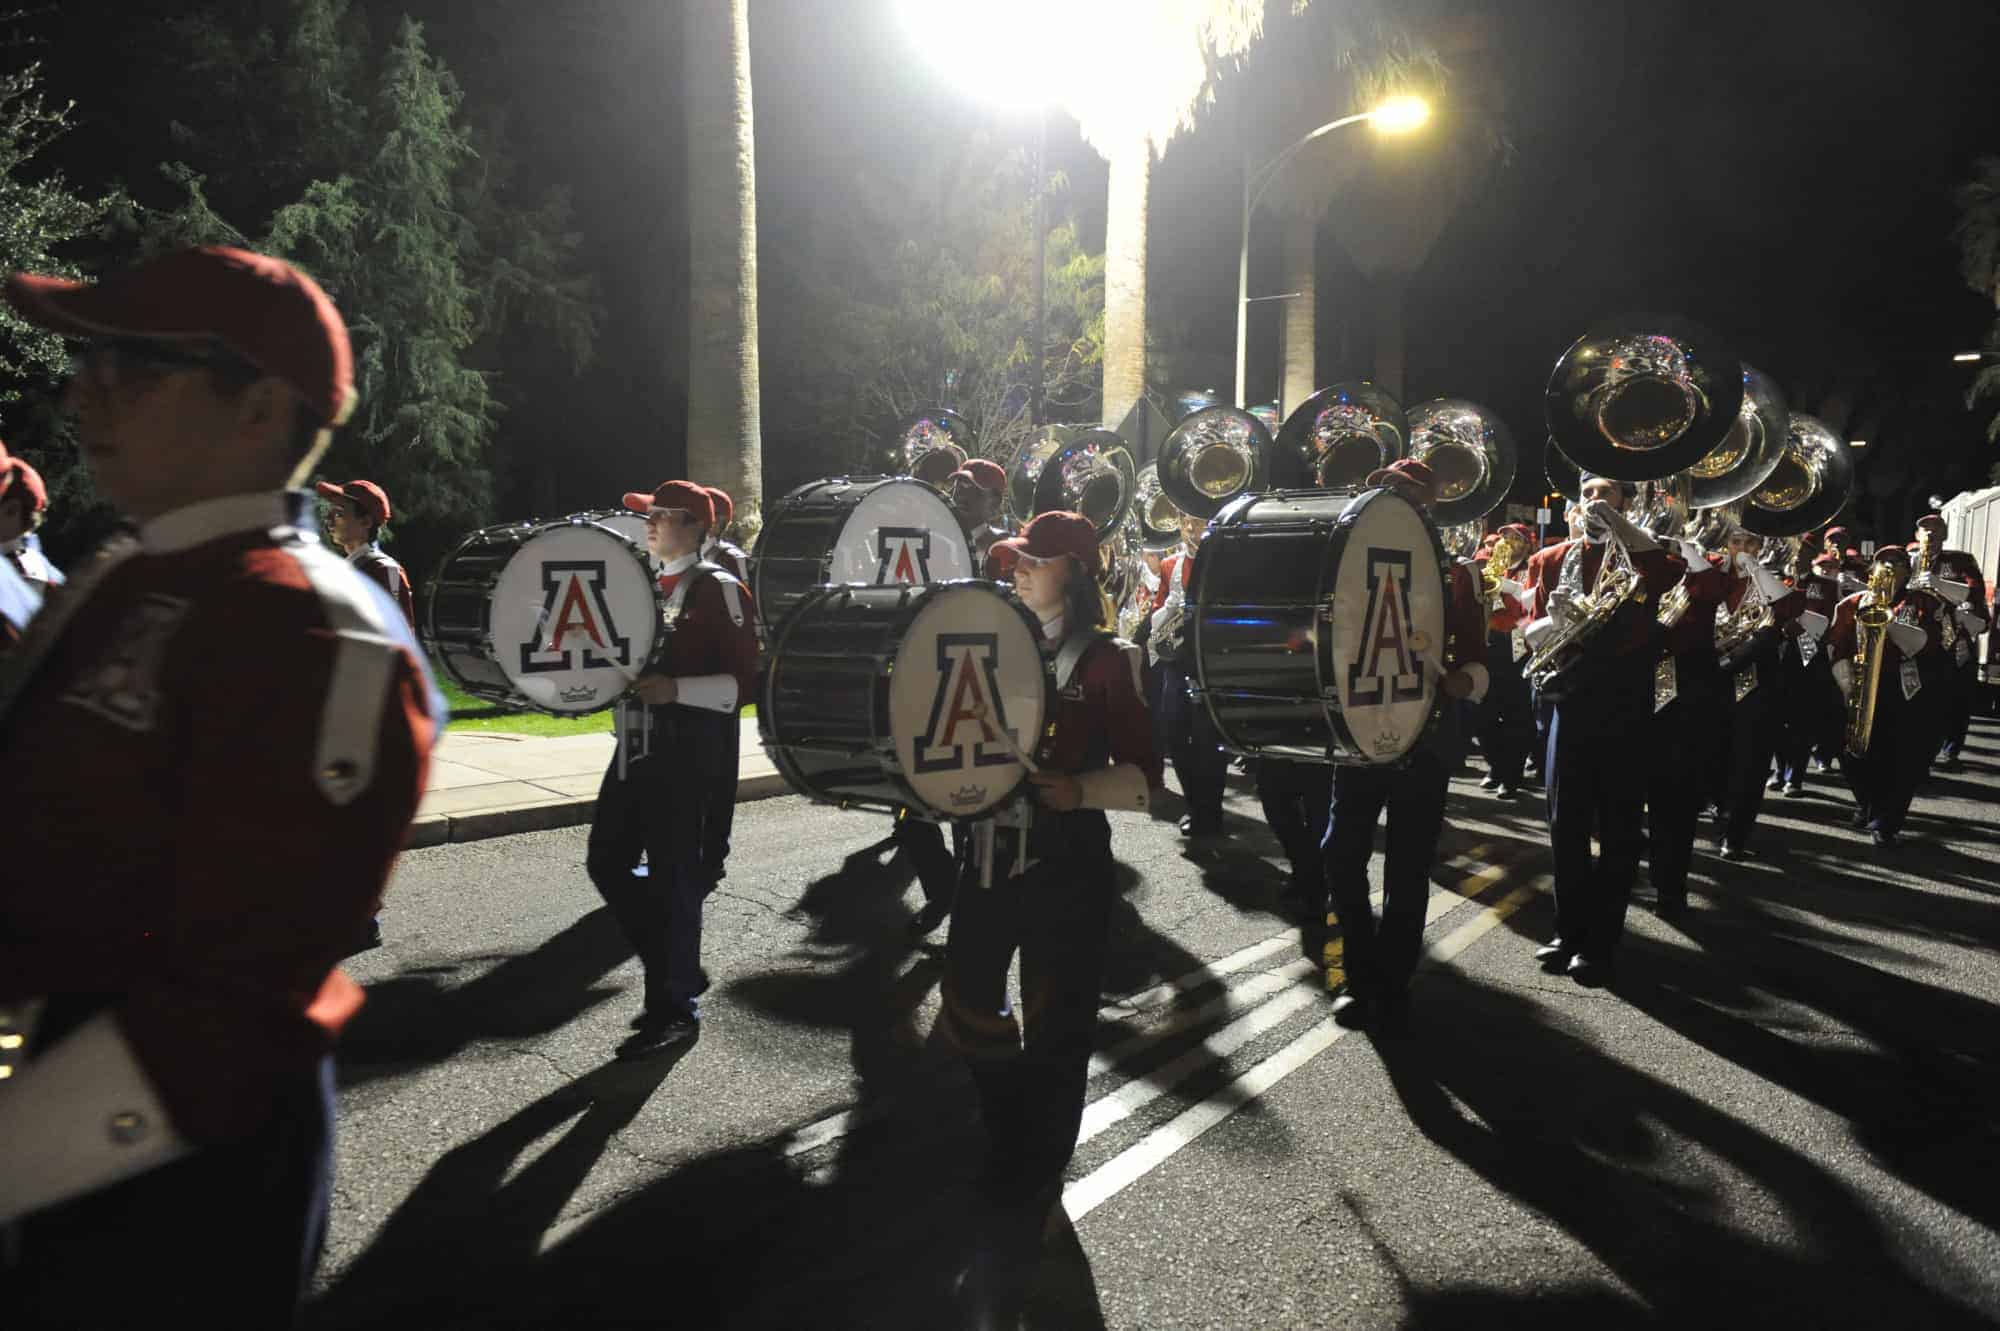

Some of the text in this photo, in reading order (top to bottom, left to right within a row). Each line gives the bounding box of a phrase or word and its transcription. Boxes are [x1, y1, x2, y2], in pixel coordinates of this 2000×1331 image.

[521, 561, 630, 673] A
[1348, 547, 1423, 707] A
[914, 633, 1019, 773] A
